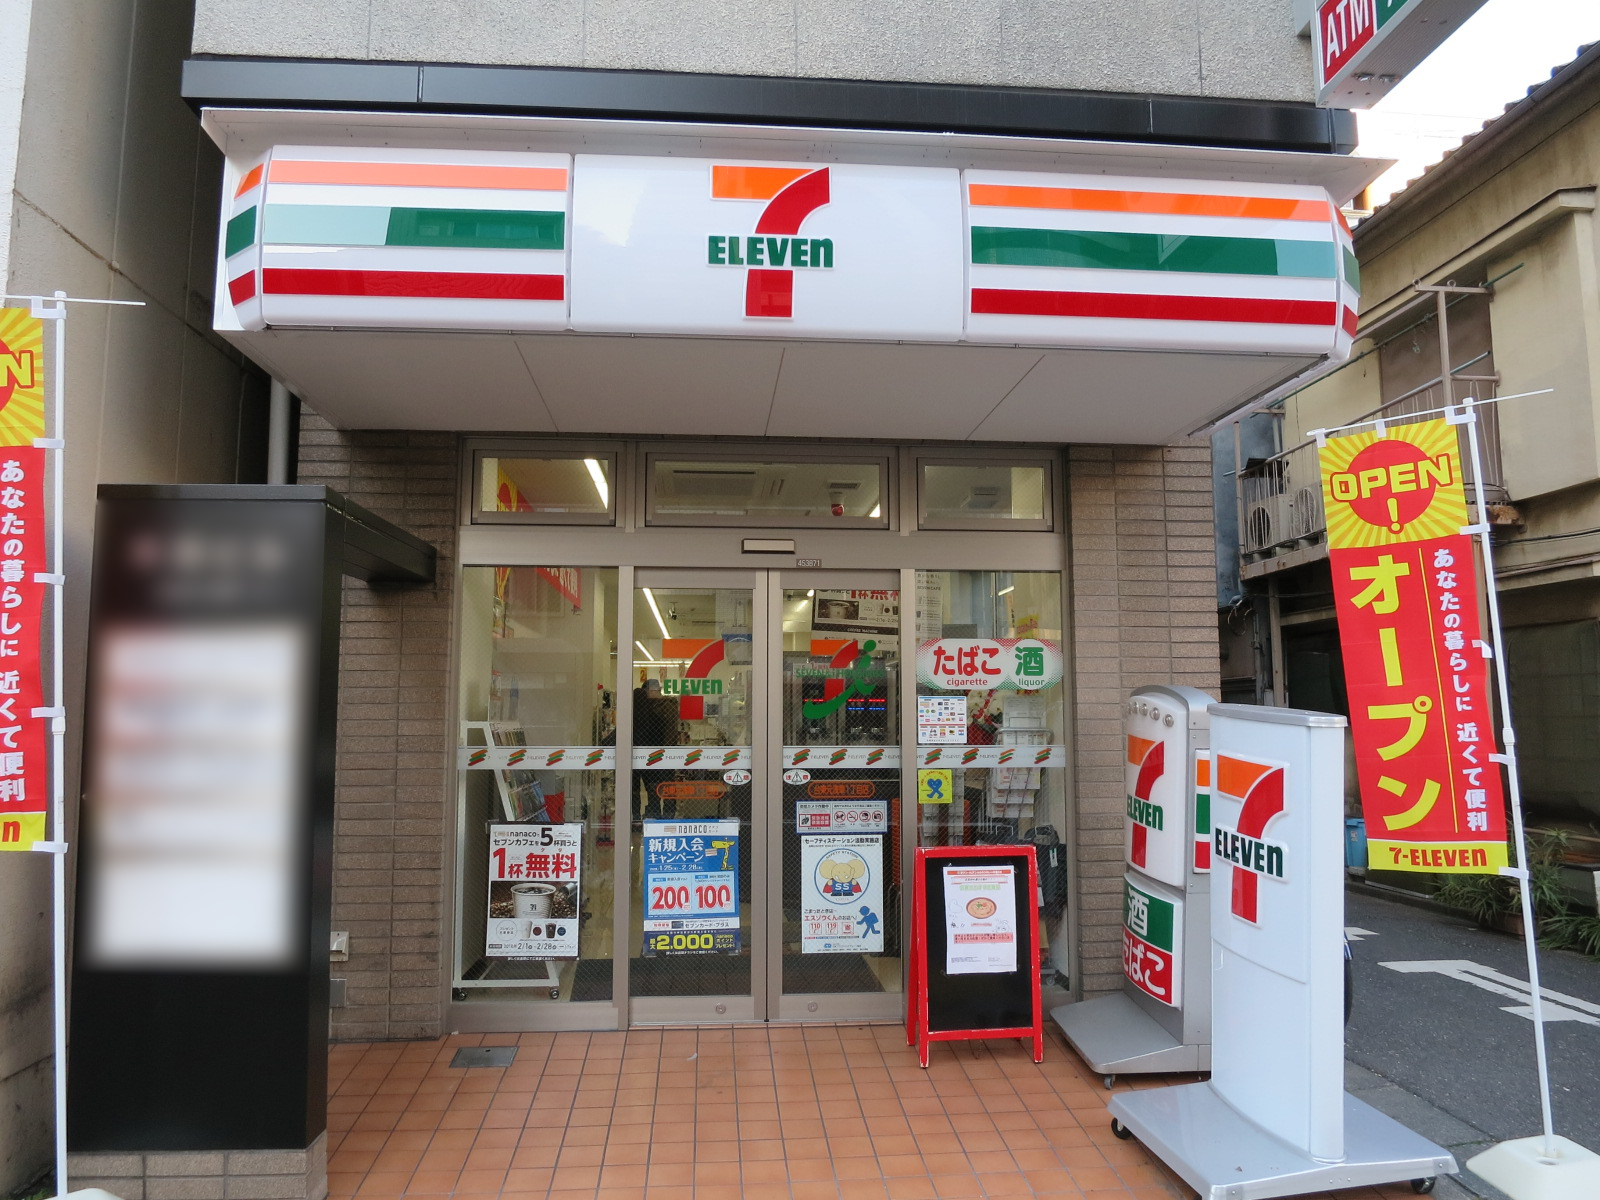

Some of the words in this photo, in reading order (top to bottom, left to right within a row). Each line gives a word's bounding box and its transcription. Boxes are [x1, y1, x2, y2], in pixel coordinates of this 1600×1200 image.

[1326, 0, 1370, 68] ATM
[1331, 453, 1452, 502] OPEN
[933, 645, 1002, 676] たばこ
[1015, 646, 1044, 676] 酒
[946, 678, 988, 687] cigarette
[1018, 678, 1045, 687] liquor
[1350, 554, 1441, 831] オープン
[1433, 548, 1472, 712] あなたの暮らしに
[1456, 721, 1488, 832] 近くて便利
[678, 825, 708, 834] nanaco
[648, 838, 705, 853] 新規入会
[648, 852, 704, 864] キャンペーン
[652, 886, 690, 909] 200
[695, 884, 731, 909] 100
[1127, 886, 1150, 937] 酒
[656, 934, 714, 950] 2,000
